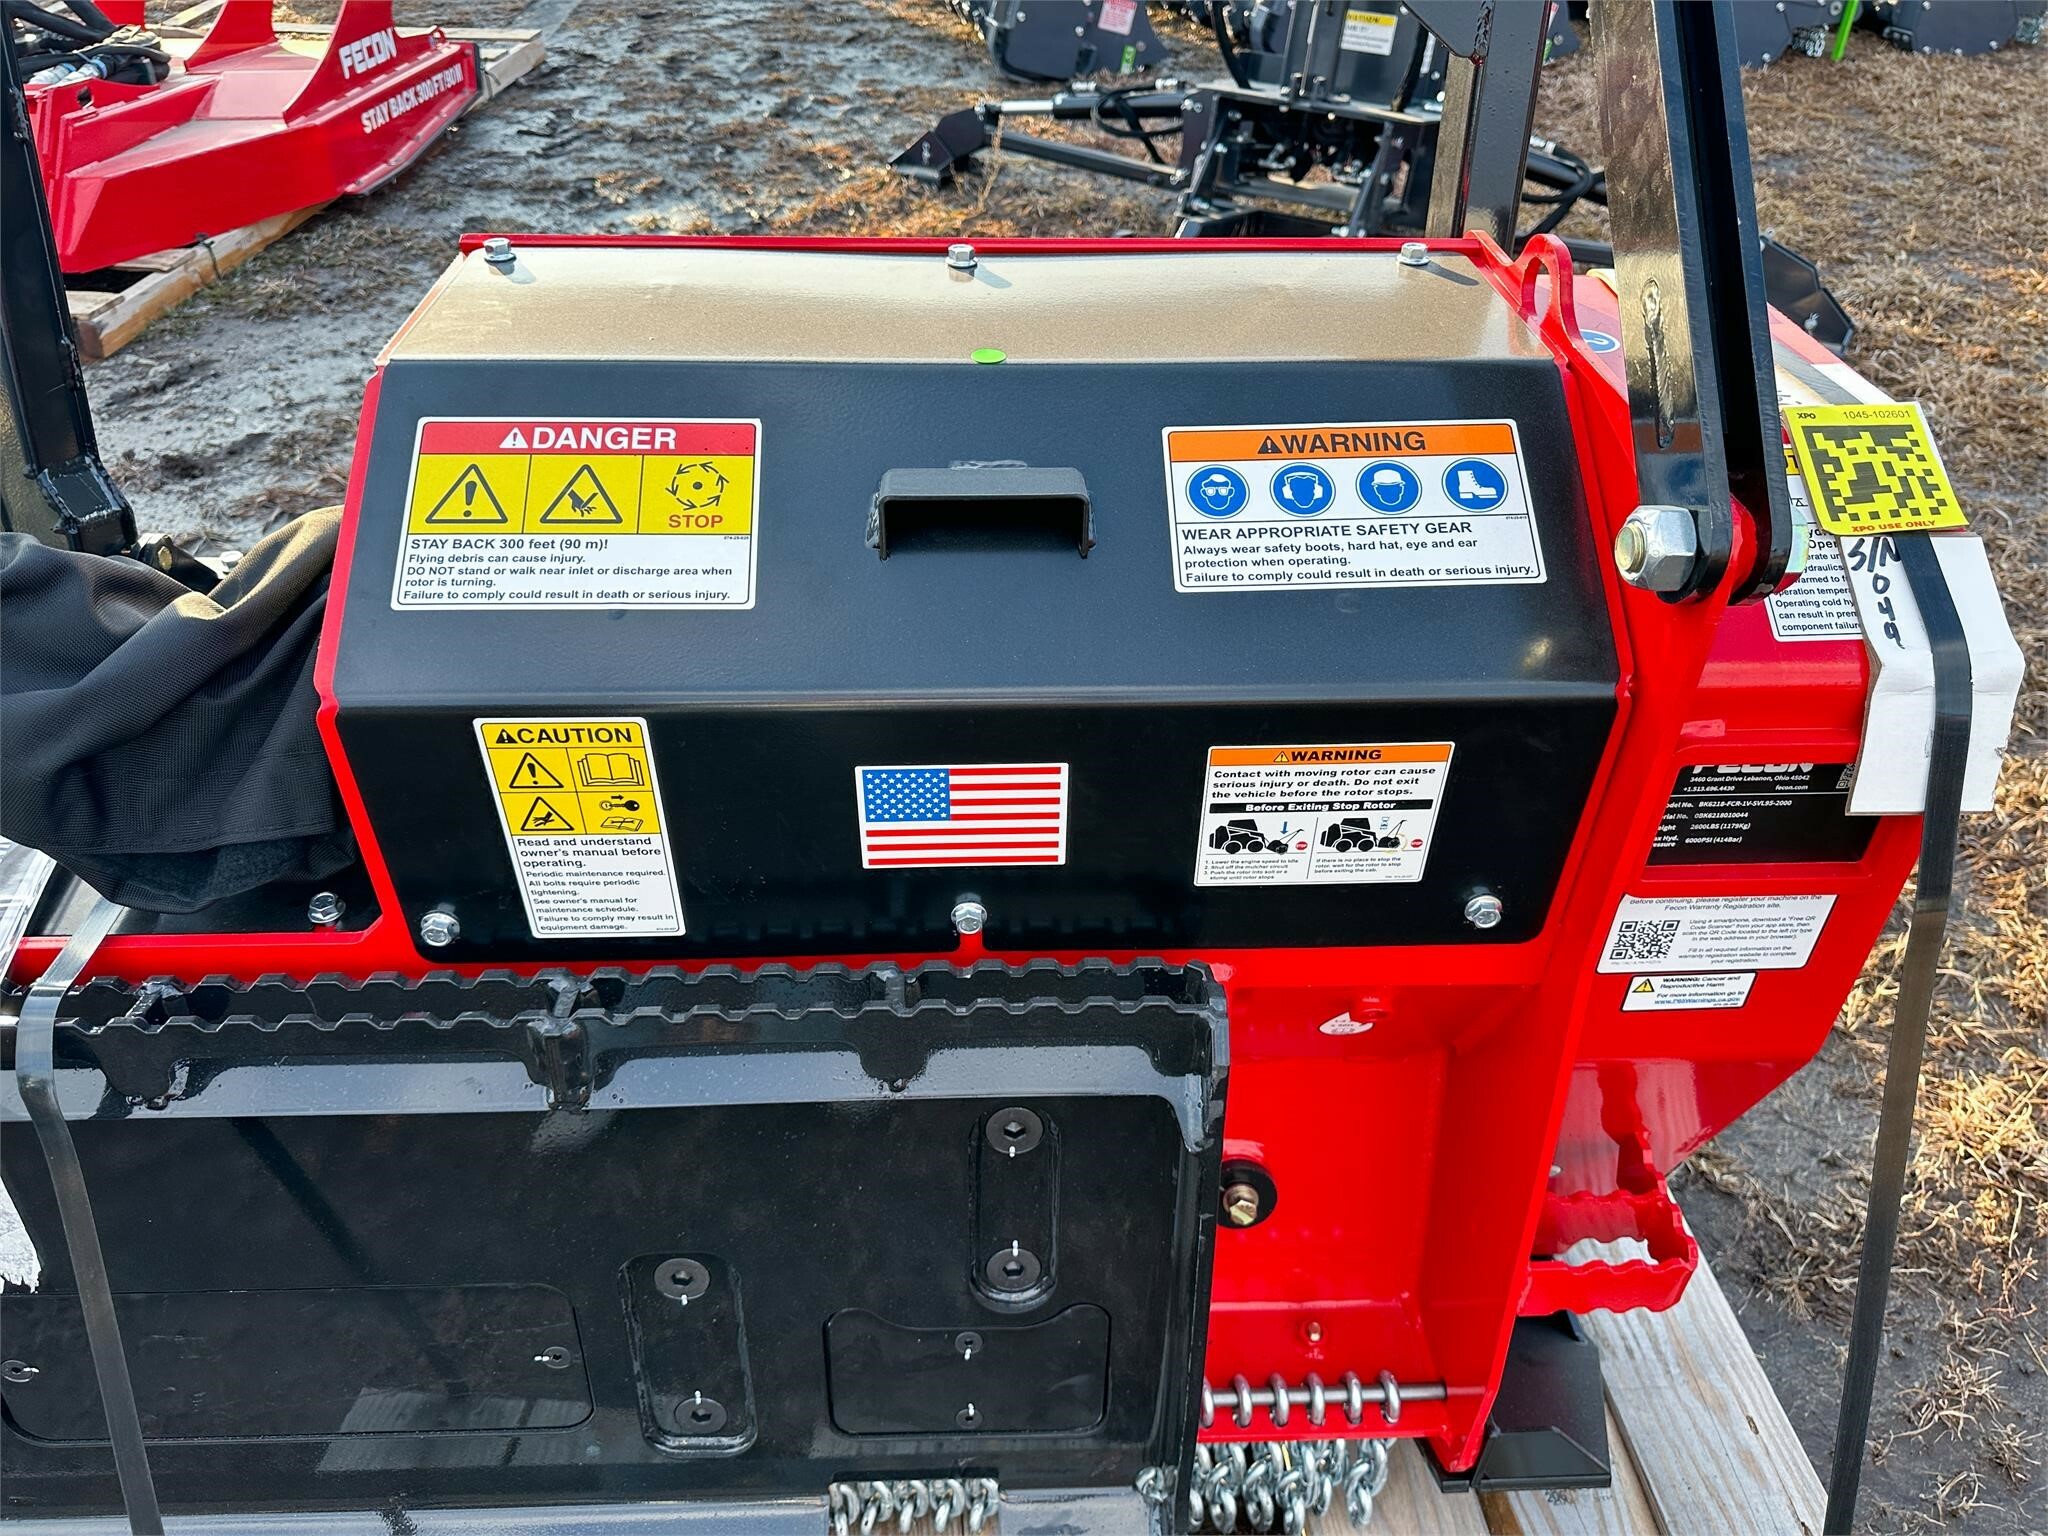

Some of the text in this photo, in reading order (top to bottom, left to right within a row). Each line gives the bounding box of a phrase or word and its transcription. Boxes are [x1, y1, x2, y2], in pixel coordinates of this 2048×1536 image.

[339, 27, 397, 79] FECON
[361, 79, 434, 134] STAY BACK 300
[1843, 409, 1910, 419] 1045-102601
[532, 427, 676, 449] DANGER
[1279, 431, 1425, 453] WARNING
[668, 514, 722, 528] STOP
[1878, 522, 1904, 530] USE
[1906, 520, 1936, 528] ONLY
[1181, 521, 1472, 539] WEAR APPROPRIATE SAFETY GEAR
[410, 538, 607, 551] STAY BACK 300 feet (90 m)!
[1183, 545, 1227, 556] Always
[1264, 543, 1301, 554] safety
[1305, 542, 1343, 551] boots,
[1347, 541, 1375, 550] hard
[1379, 540, 1402, 550] hat,
[1406, 541, 1427, 550] eye
[1431, 538, 1454, 548] and
[1457, 539, 1477, 547] ear
[408, 554, 444, 564] Flying
[447, 553, 484, 562] debris
[550, 553, 585, 564] injury.
[1184, 555, 1350, 569] protection when operating.
[407, 566, 425, 575] DO
[428, 566, 454, 575] NOT
[457, 566, 490, 578] stand
[509, 566, 535, 574] walk
[568, 566, 593, 574] inlet
[612, 566, 669, 577] discharge
[701, 566, 731, 575] when
[1186, 572, 1228, 581] Failure
[1231, 572, 1244, 581] to
[1247, 571, 1292, 581] comply
[1296, 569, 1331, 579] could
[1335, 568, 1371, 578] result
[1374, 568, 1385, 577] in
[1389, 566, 1425, 576] death
[1445, 565, 1492, 575] serious
[1495, 564, 1534, 576] injury.
[405, 577, 495, 588] rotor is turning.
[403, 590, 443, 599] Failure
[447, 590, 458, 598] to
[462, 590, 505, 600] comply
[508, 589, 541, 598] could
[545, 590, 578, 598] result
[582, 589, 592, 598] in
[596, 589, 628, 598] death
[648, 590, 691, 598] serious
[695, 590, 729, 600] injury.
[1797, 610, 1823, 618] result
[516, 727, 632, 743] CAUTION
[1291, 750, 1382, 761] WARNING
[1294, 769, 1337, 777] moving
[1259, 780, 1293, 788] injury
[1312, 778, 1349, 786] death.
[1279, 789, 1317, 797] before
[1377, 788, 1412, 796] stops.
[1246, 801, 1396, 812] Before Exiting Stop Rotor
[1719, 822, 1750, 830] (1179Kg)
[517, 838, 549, 846] Read
[580, 837, 651, 845] understand
[520, 847, 660, 856] owner's manual before
[523, 859, 585, 868] operating.
[625, 869, 666, 877] required.
[540, 924, 587, 932] equipment
